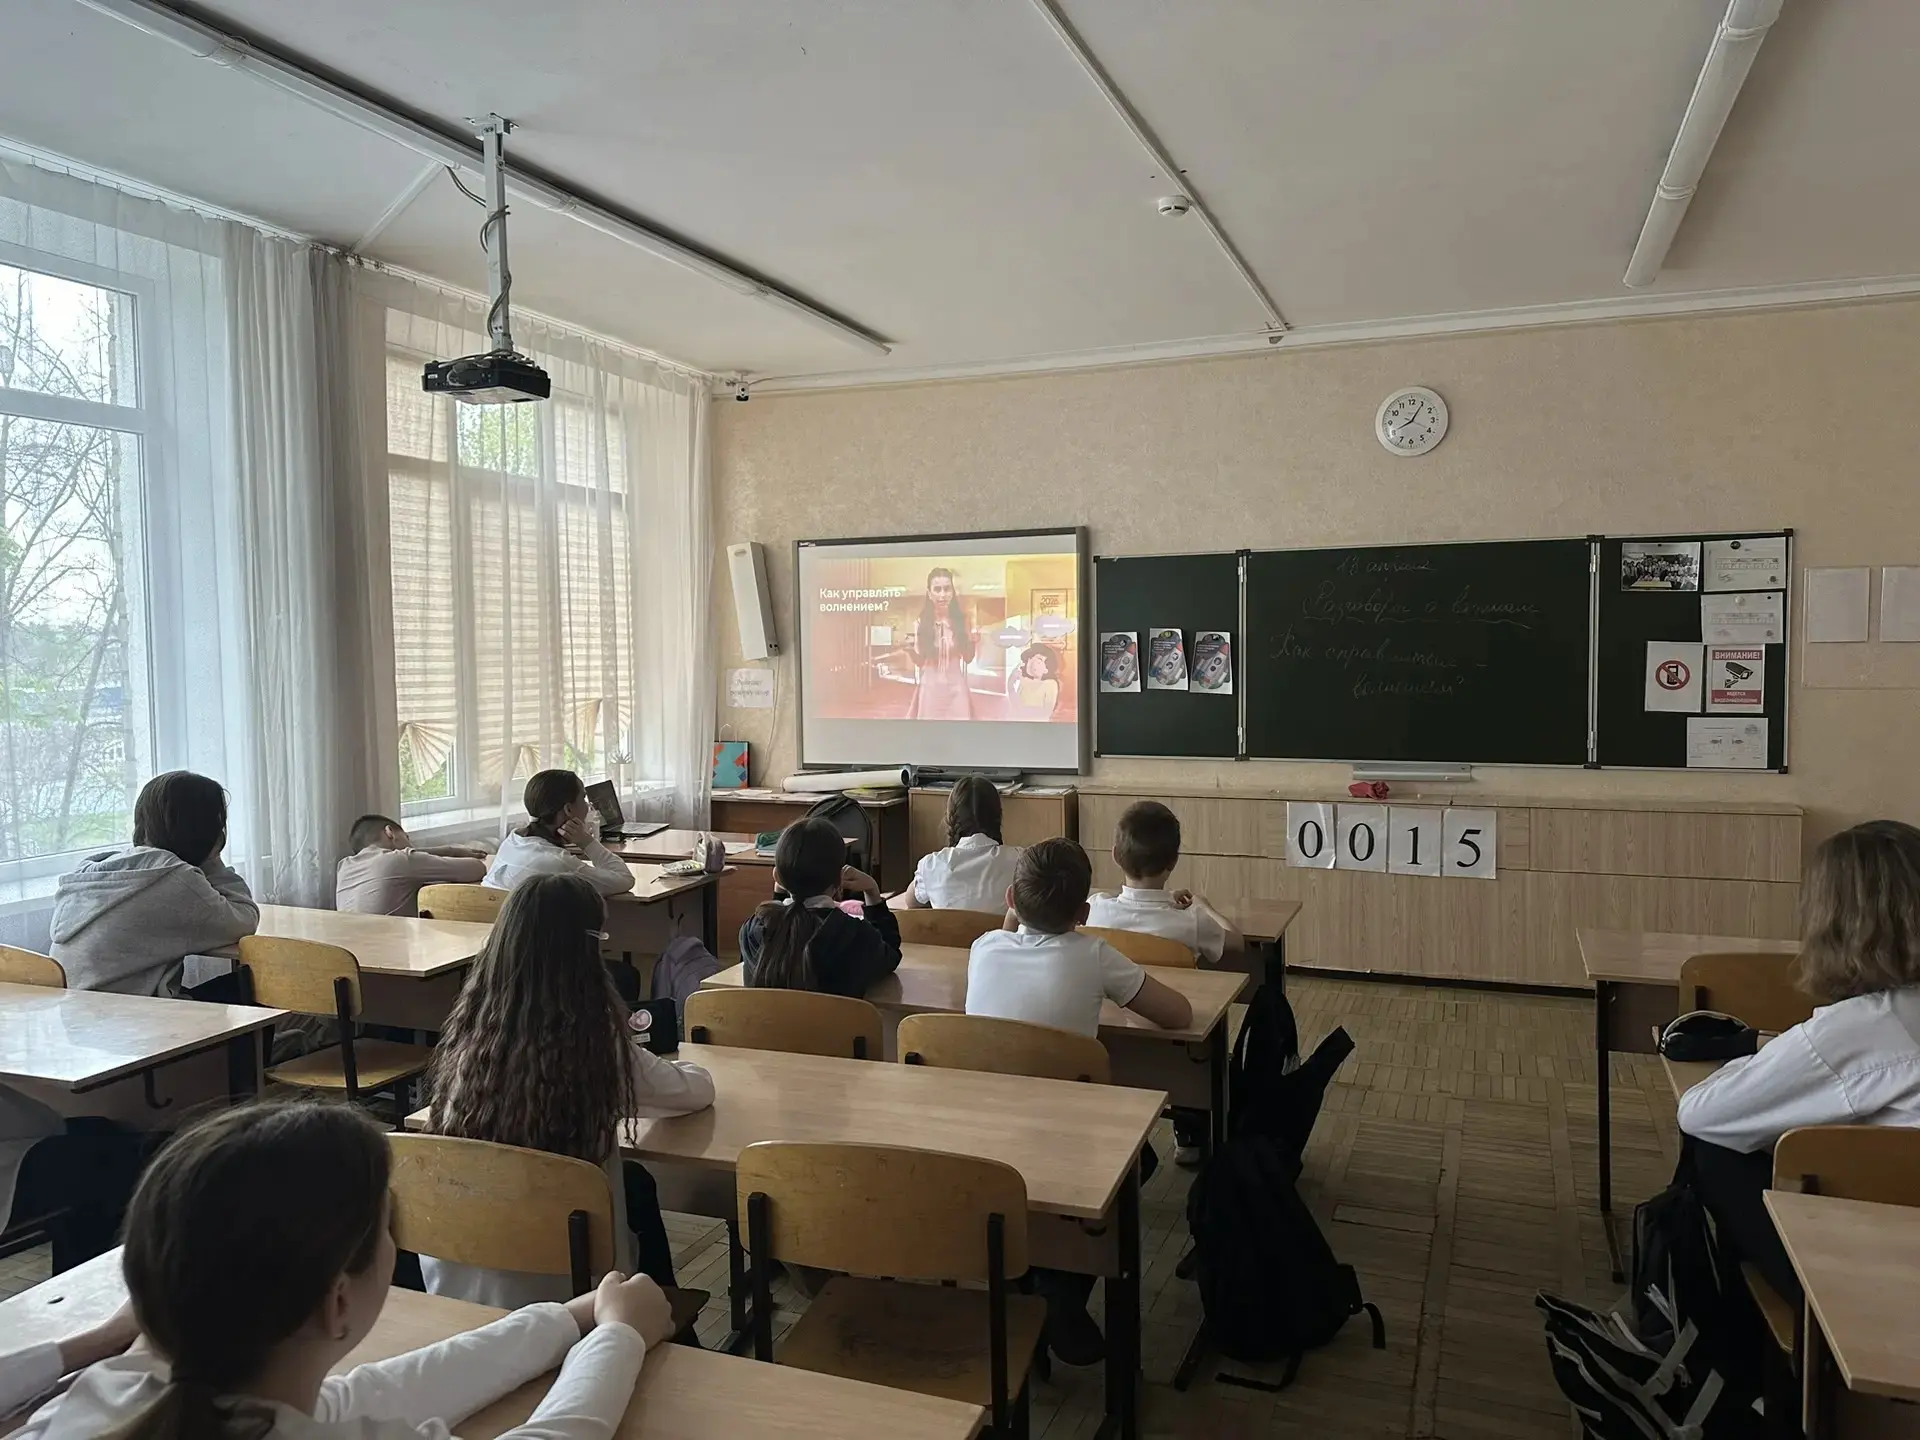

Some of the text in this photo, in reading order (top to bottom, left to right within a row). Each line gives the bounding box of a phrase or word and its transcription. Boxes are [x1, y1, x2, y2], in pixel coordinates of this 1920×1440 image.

[819, 588, 901, 601] Как управлять
[819, 601, 889, 612] волнением?
[1715, 652, 1760, 660] ВНИМАНИЕ!
